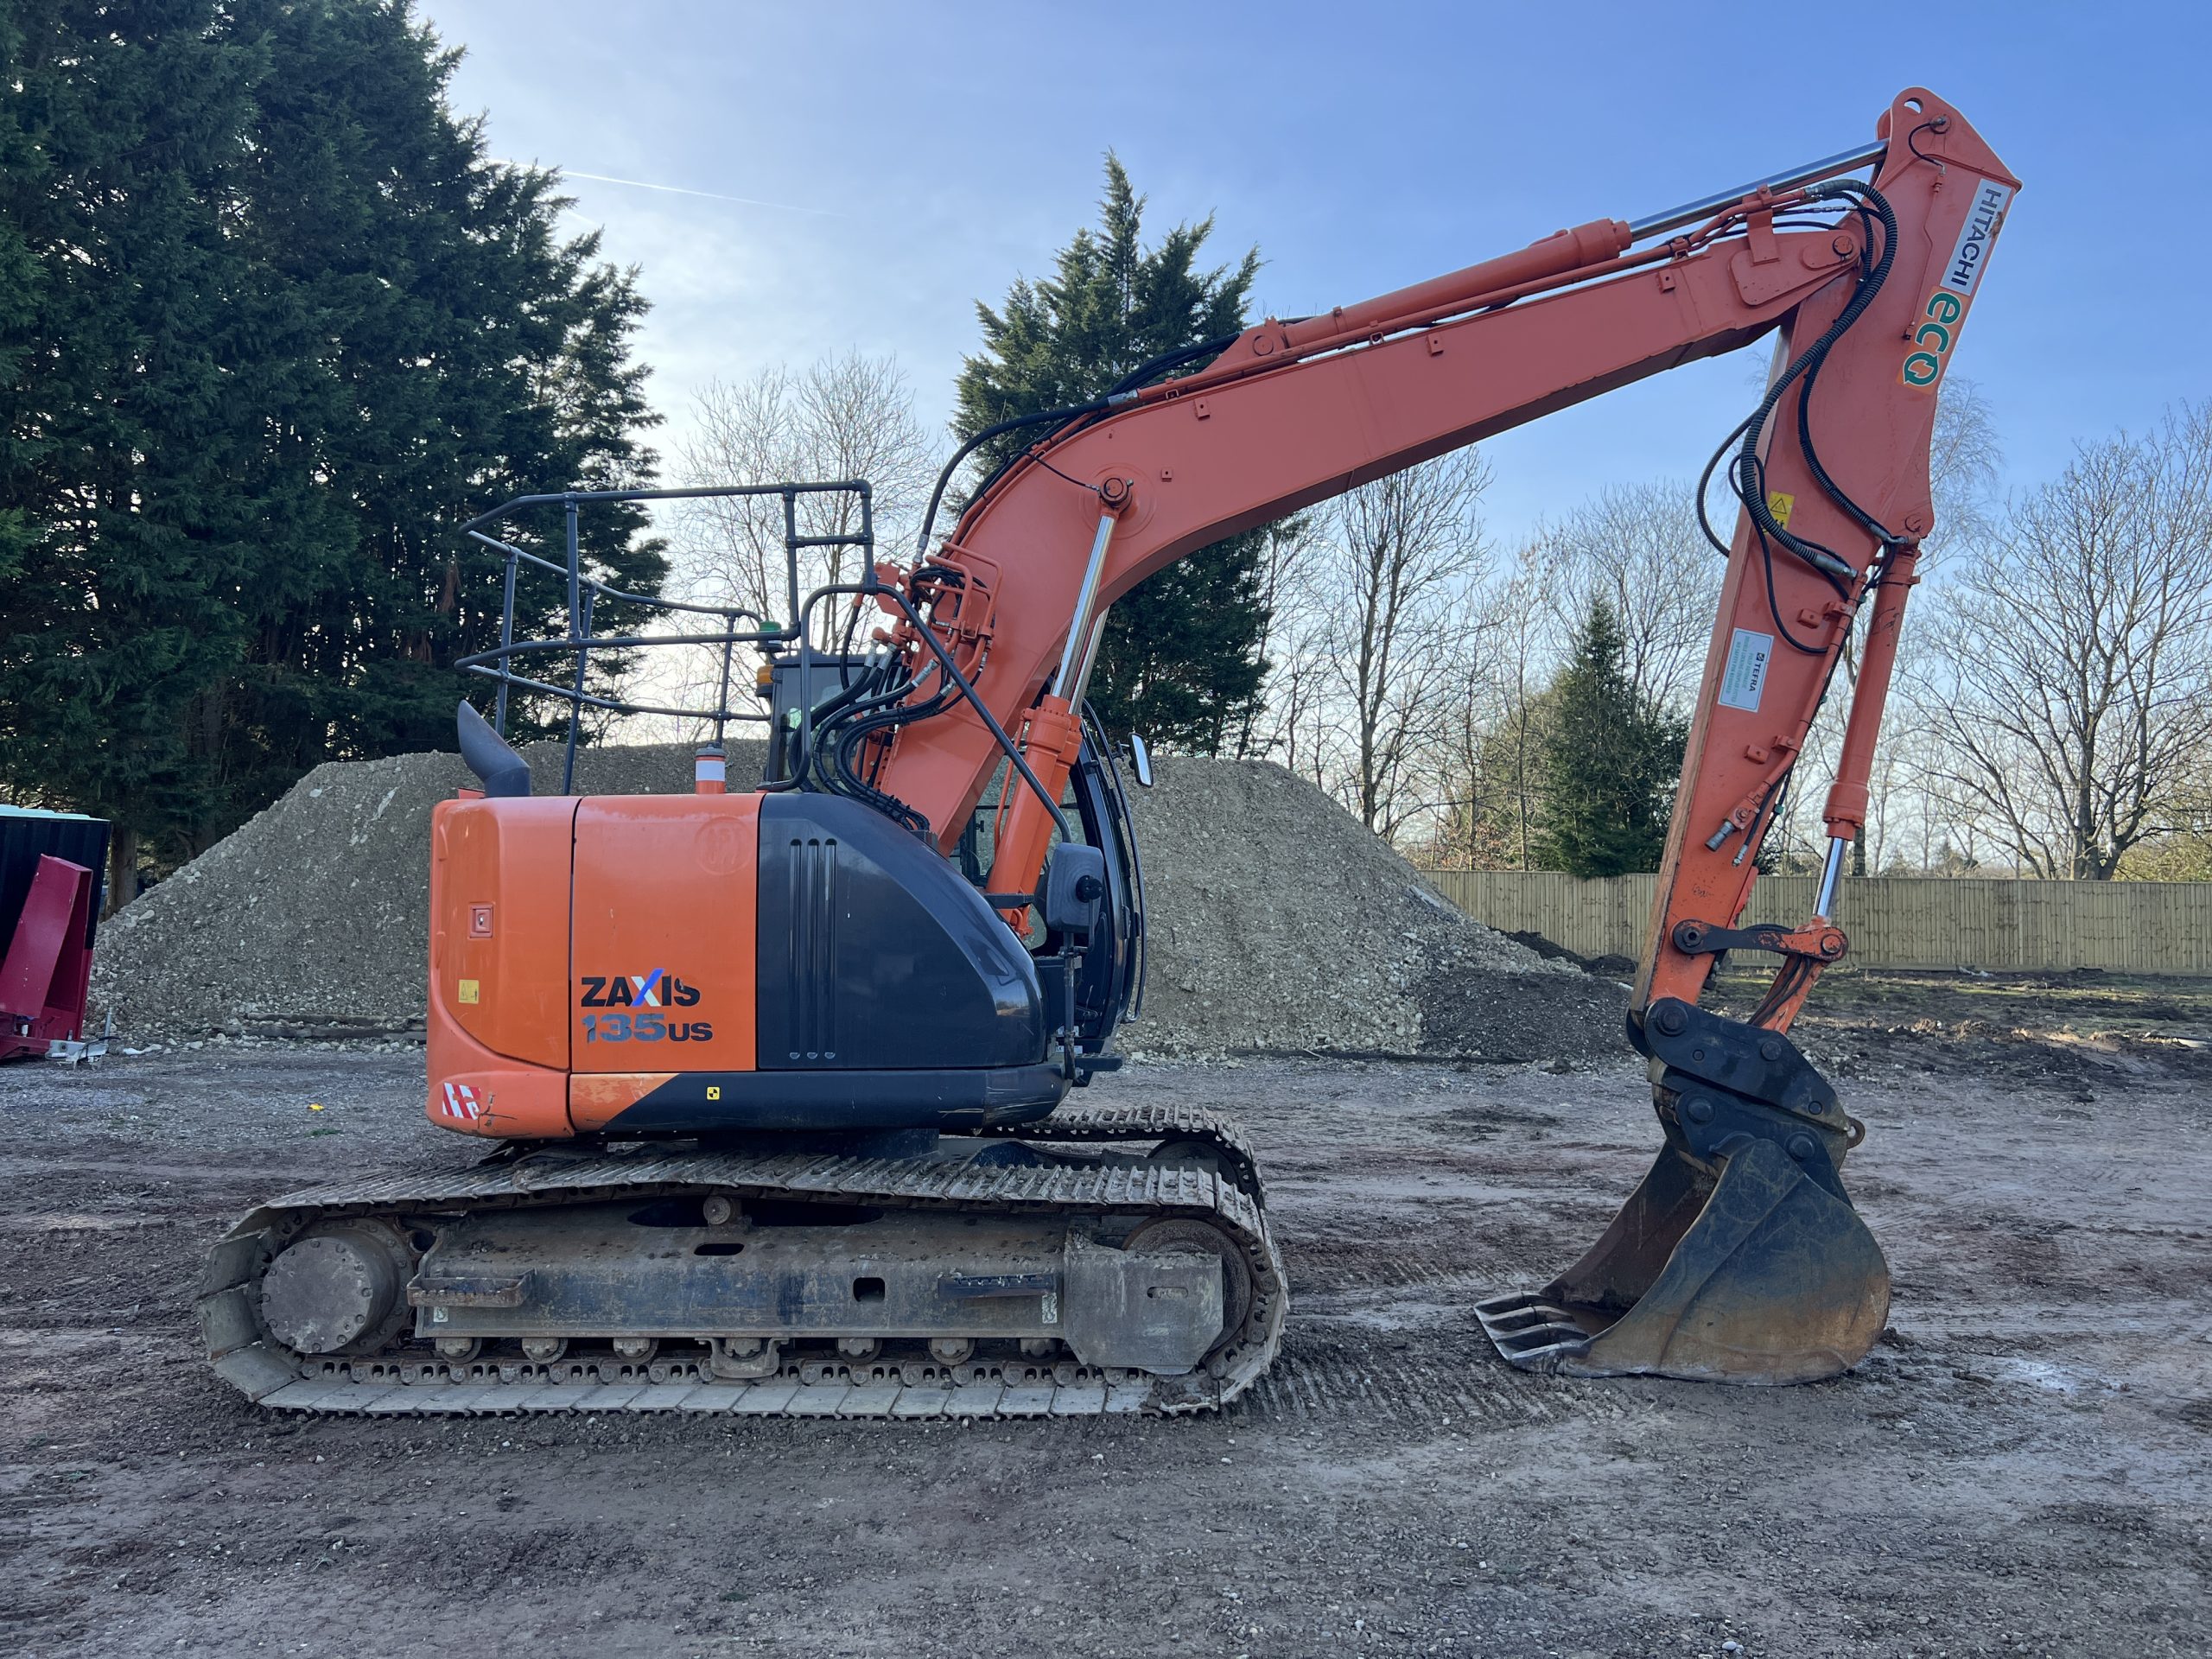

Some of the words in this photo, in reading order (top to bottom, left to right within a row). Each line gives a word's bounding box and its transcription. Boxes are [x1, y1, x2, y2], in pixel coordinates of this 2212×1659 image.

[1950, 188, 2002, 287] HITACHI
[1903, 291, 1962, 385] eco
[1749, 663, 1761, 691] TEFRA
[581, 968, 701, 1007] ZAXIS
